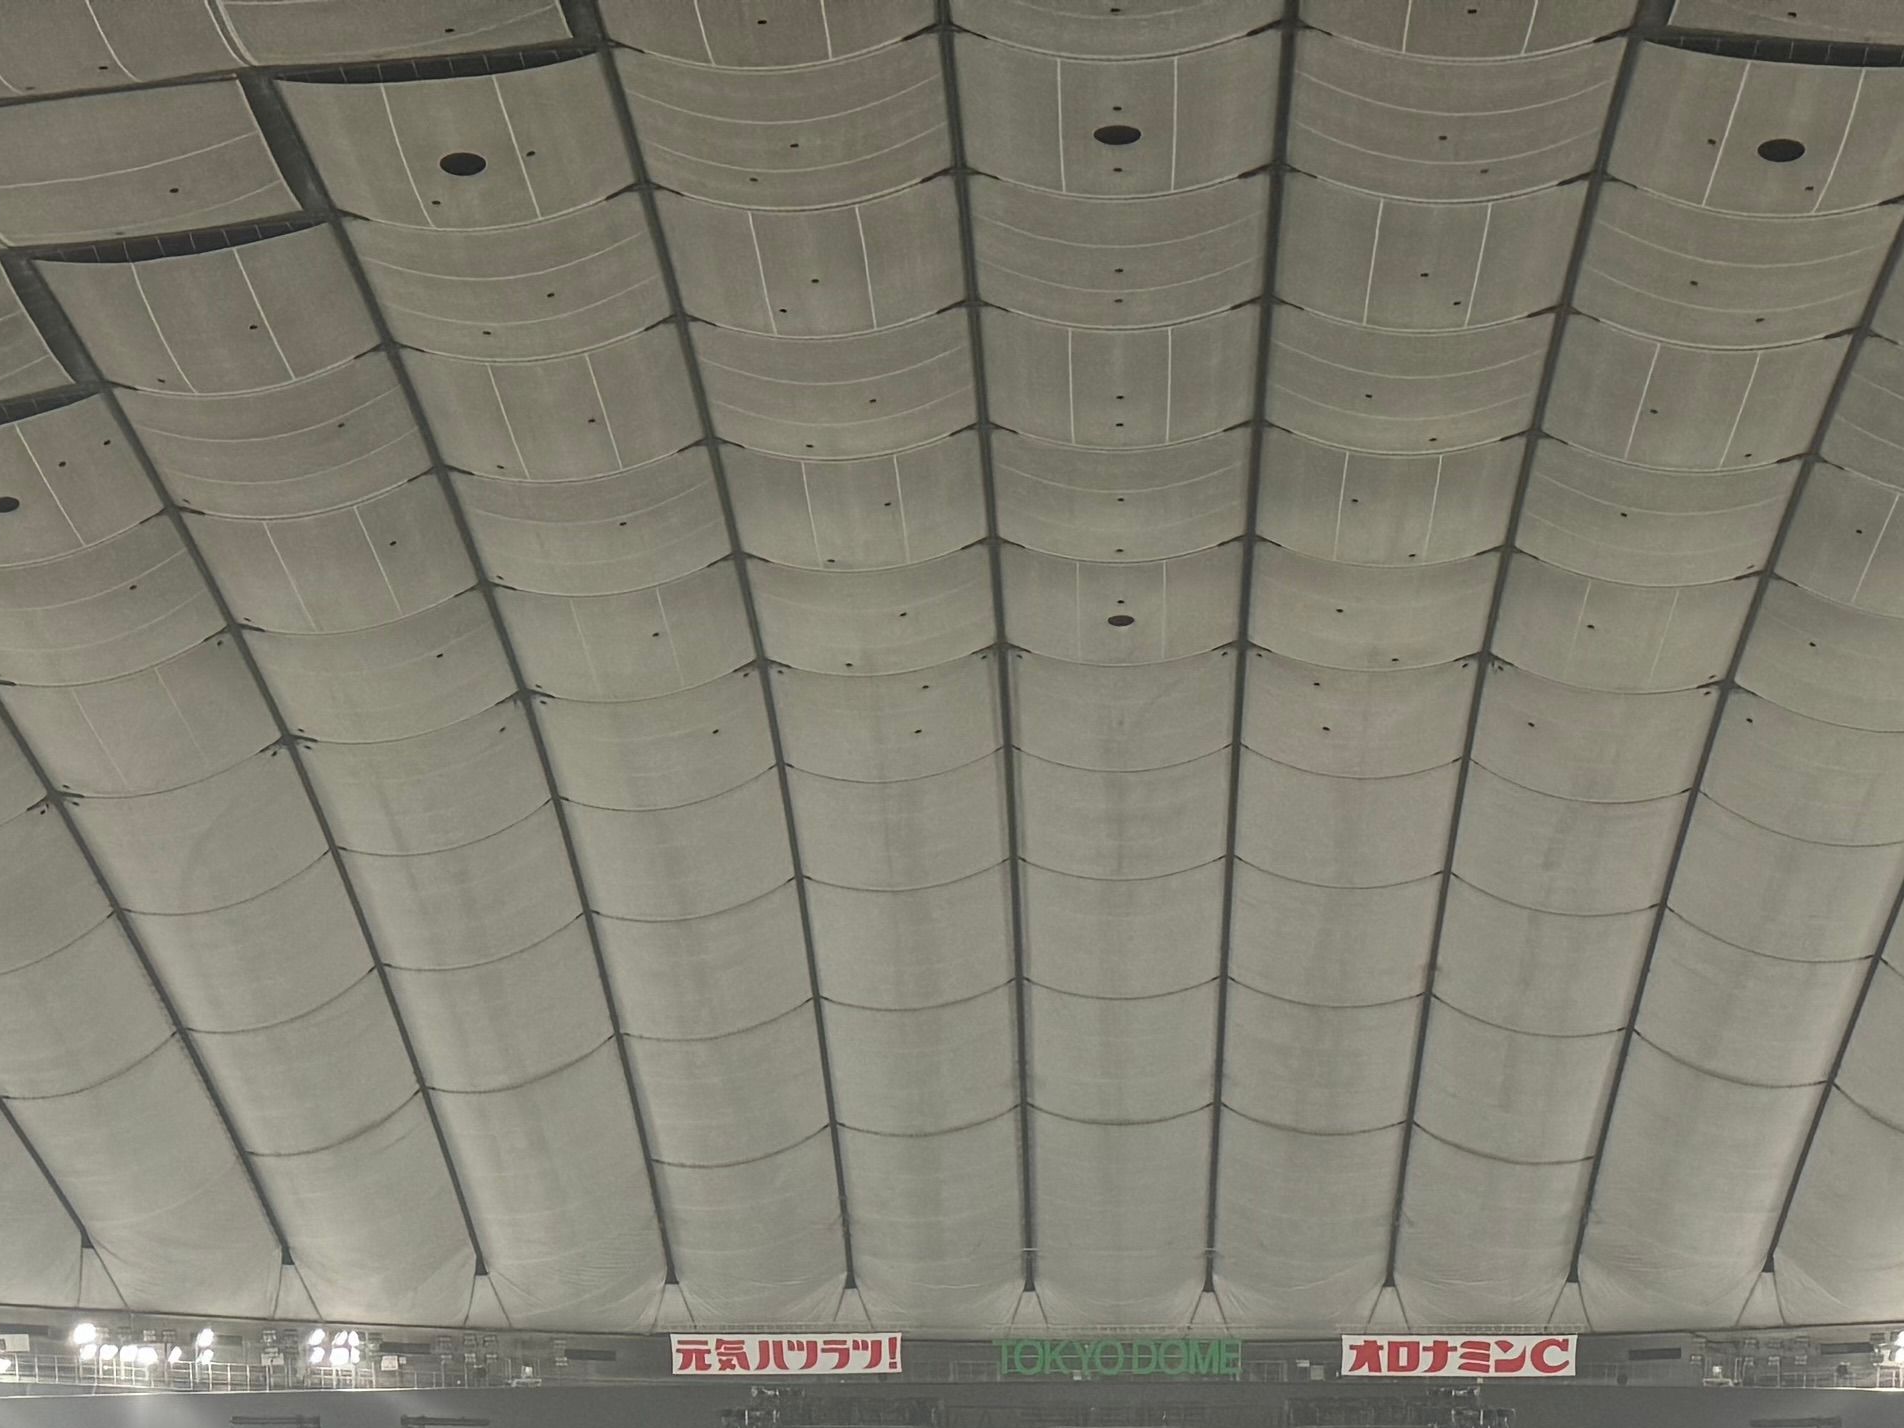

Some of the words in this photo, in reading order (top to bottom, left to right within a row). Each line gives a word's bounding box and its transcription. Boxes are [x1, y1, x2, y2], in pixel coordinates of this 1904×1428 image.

[675, 1336, 898, 1371] 元気ハツラツ!
[993, 1338, 1124, 1376] TOKYO
[1131, 1338, 1243, 1375] DOME
[1348, 1338, 1570, 1374] オロナミンC
